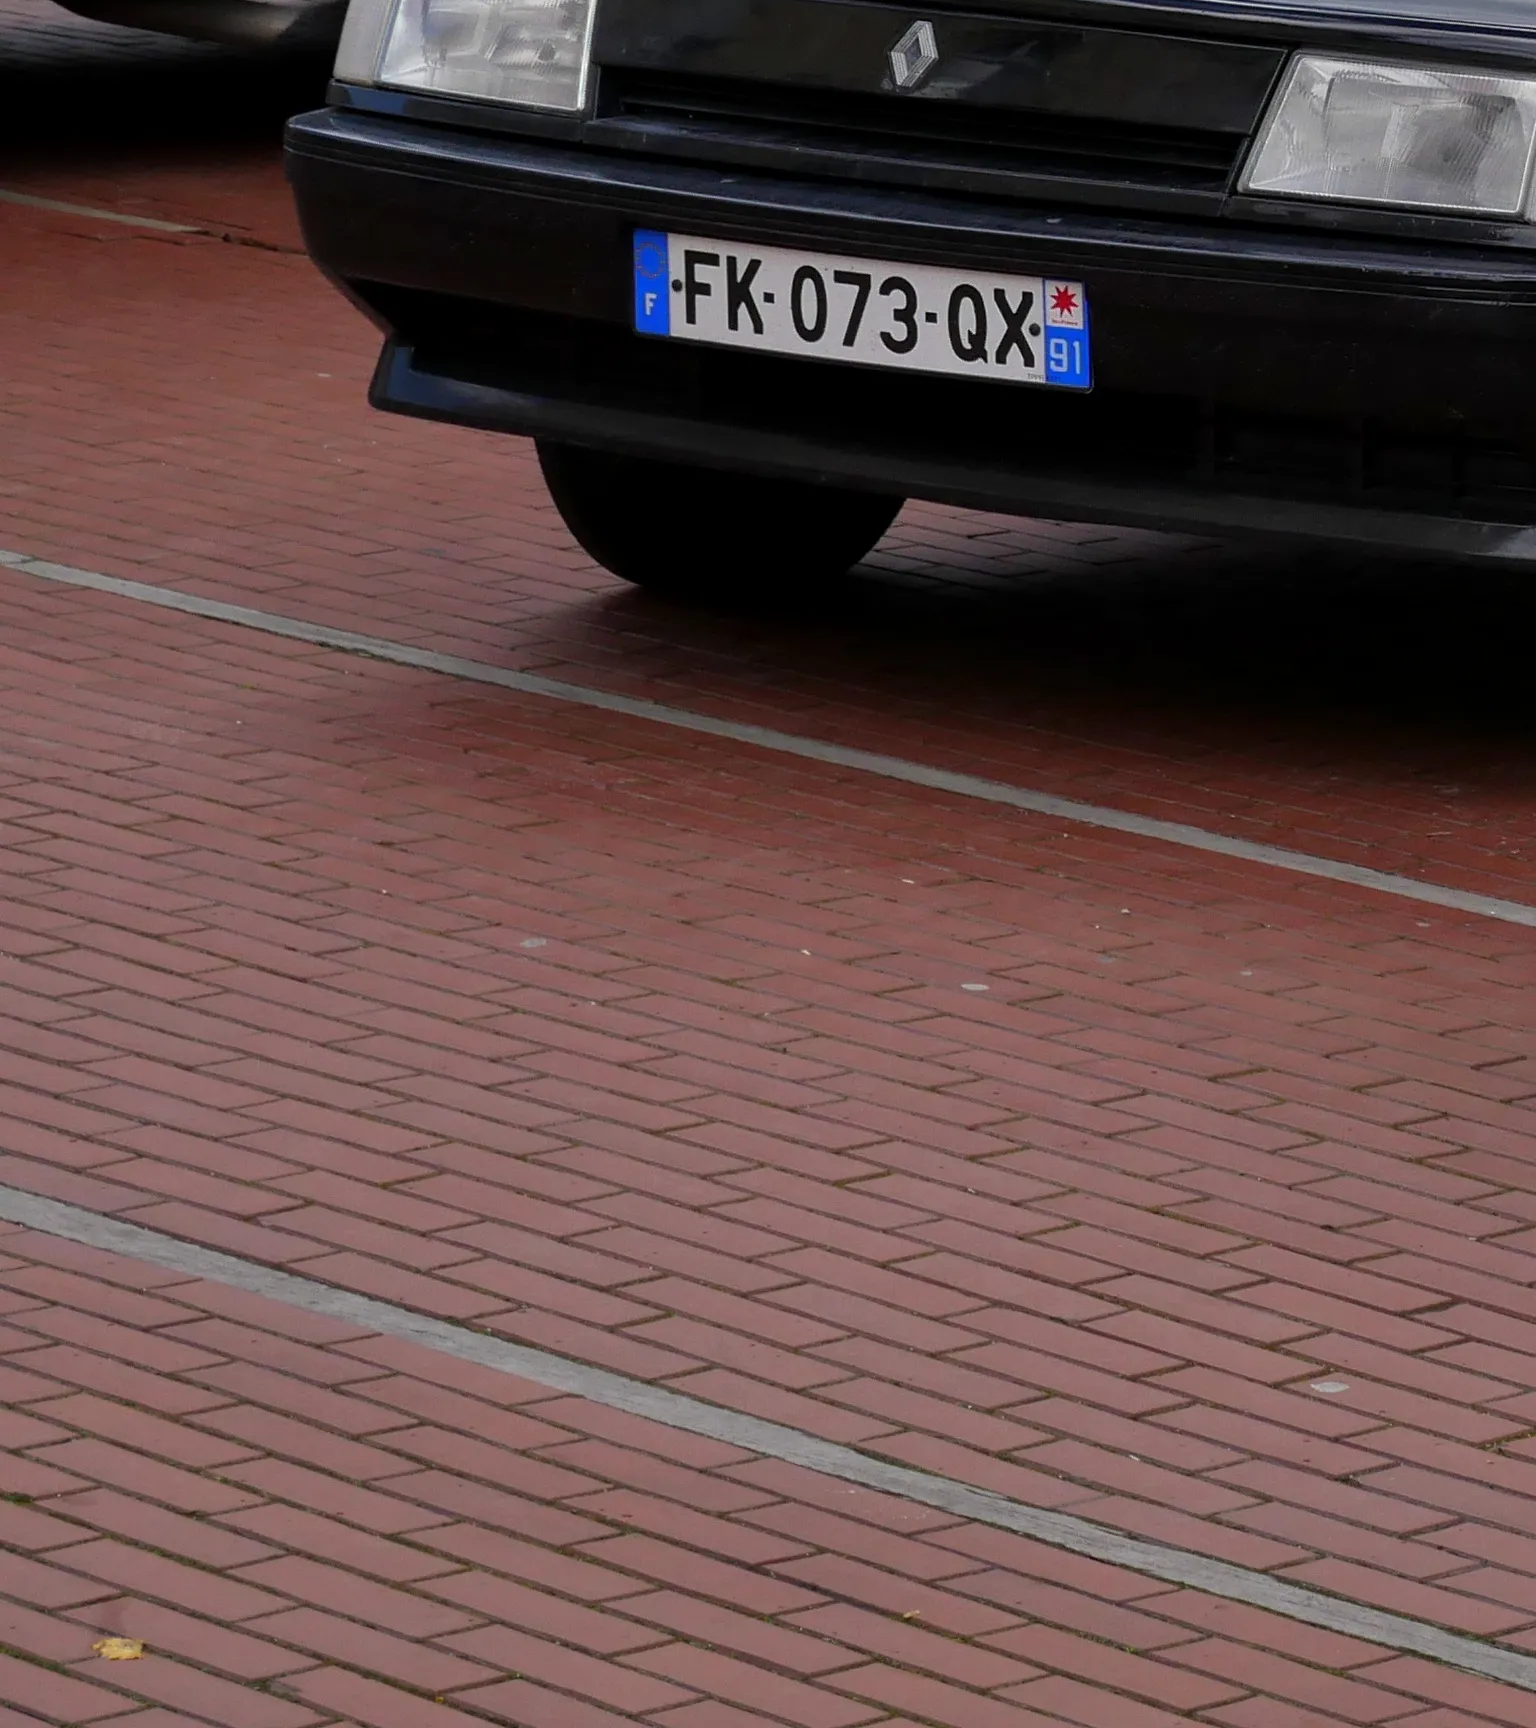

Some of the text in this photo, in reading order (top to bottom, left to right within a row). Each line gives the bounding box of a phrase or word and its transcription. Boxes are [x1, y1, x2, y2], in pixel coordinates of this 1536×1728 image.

[645, 249, 1035, 369] F FK-073-QX
[1050, 338, 1080, 375] 91
